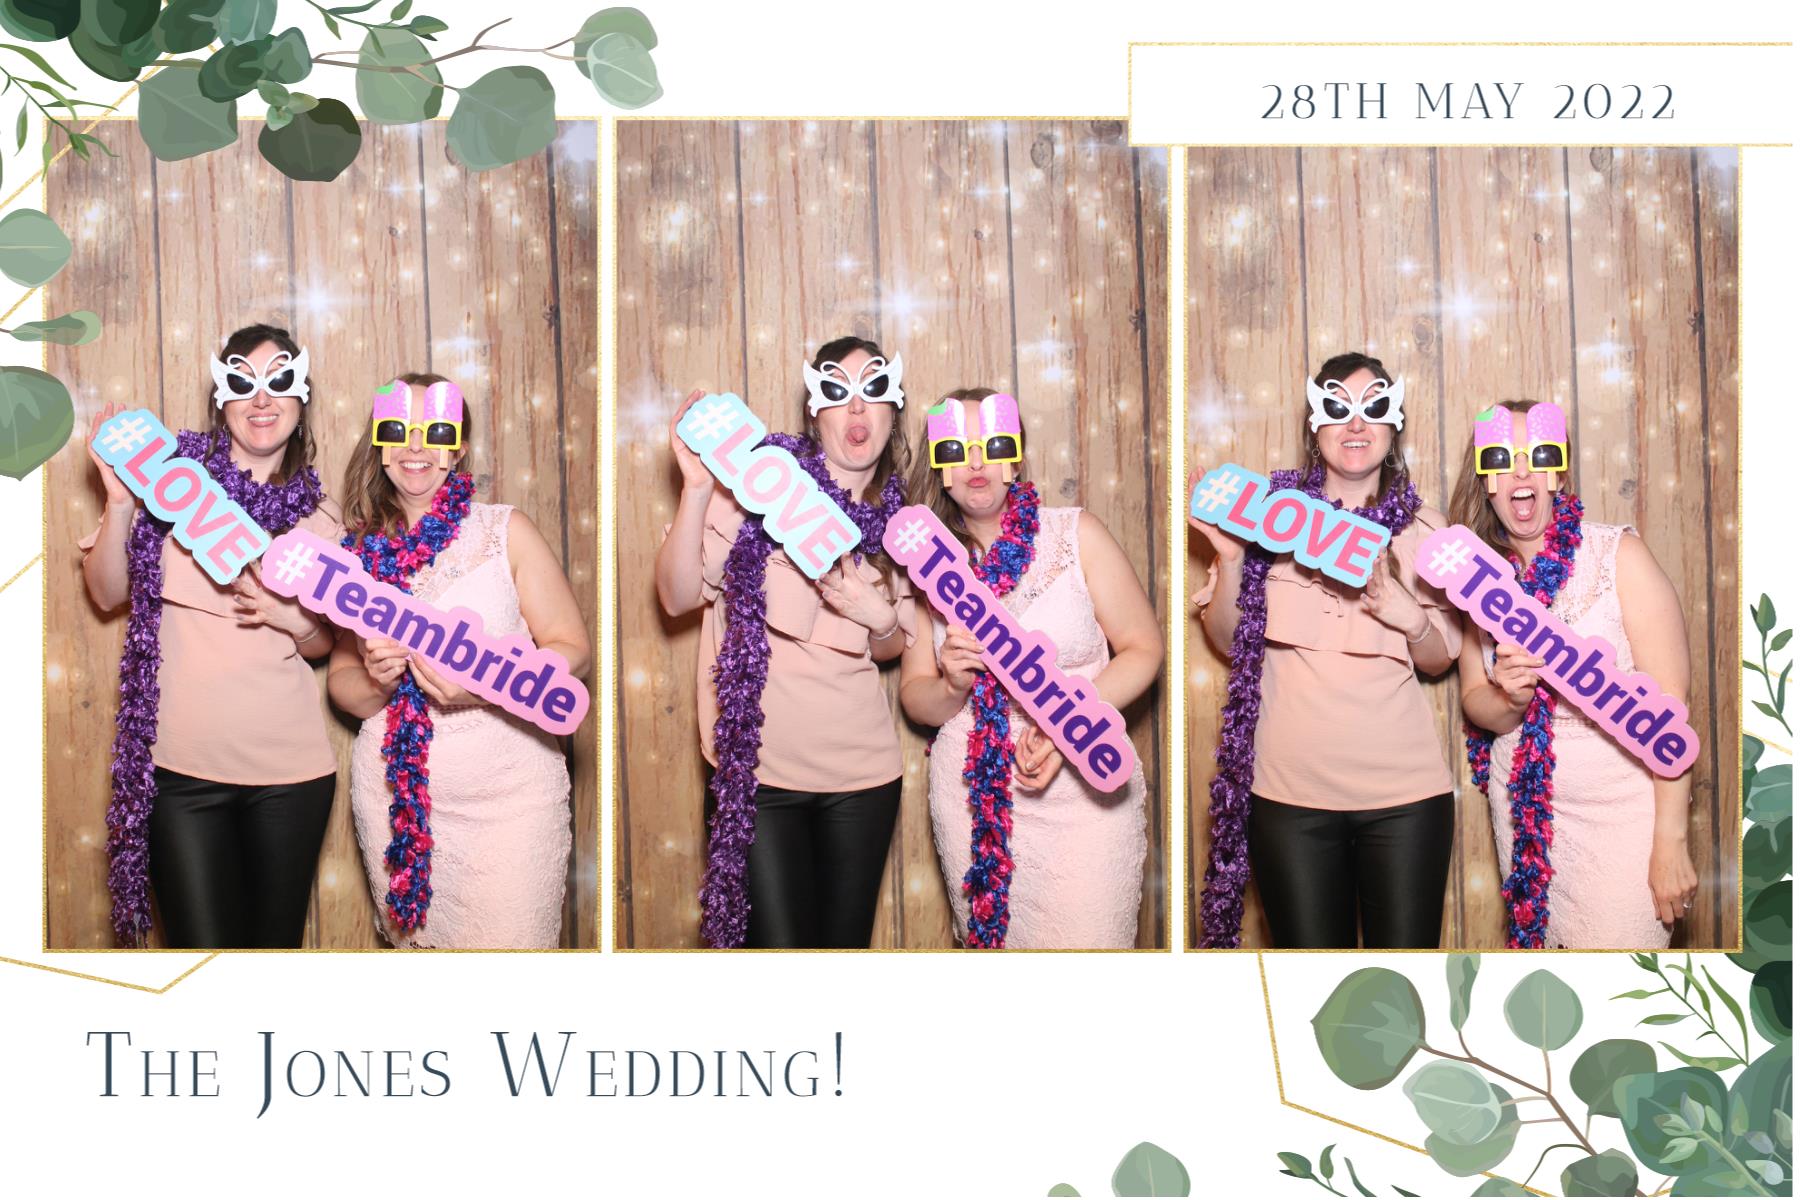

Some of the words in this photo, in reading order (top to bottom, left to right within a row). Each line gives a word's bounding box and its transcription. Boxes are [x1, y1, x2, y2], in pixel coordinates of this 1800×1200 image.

[102, 412, 262, 577] #LOVE
[686, 399, 854, 570] #LOVE
[1199, 470, 1383, 577] #LOVE
[275, 542, 577, 724] #Teambride
[893, 518, 1122, 780] #Teambride
[1430, 538, 1687, 766] #Teambride
